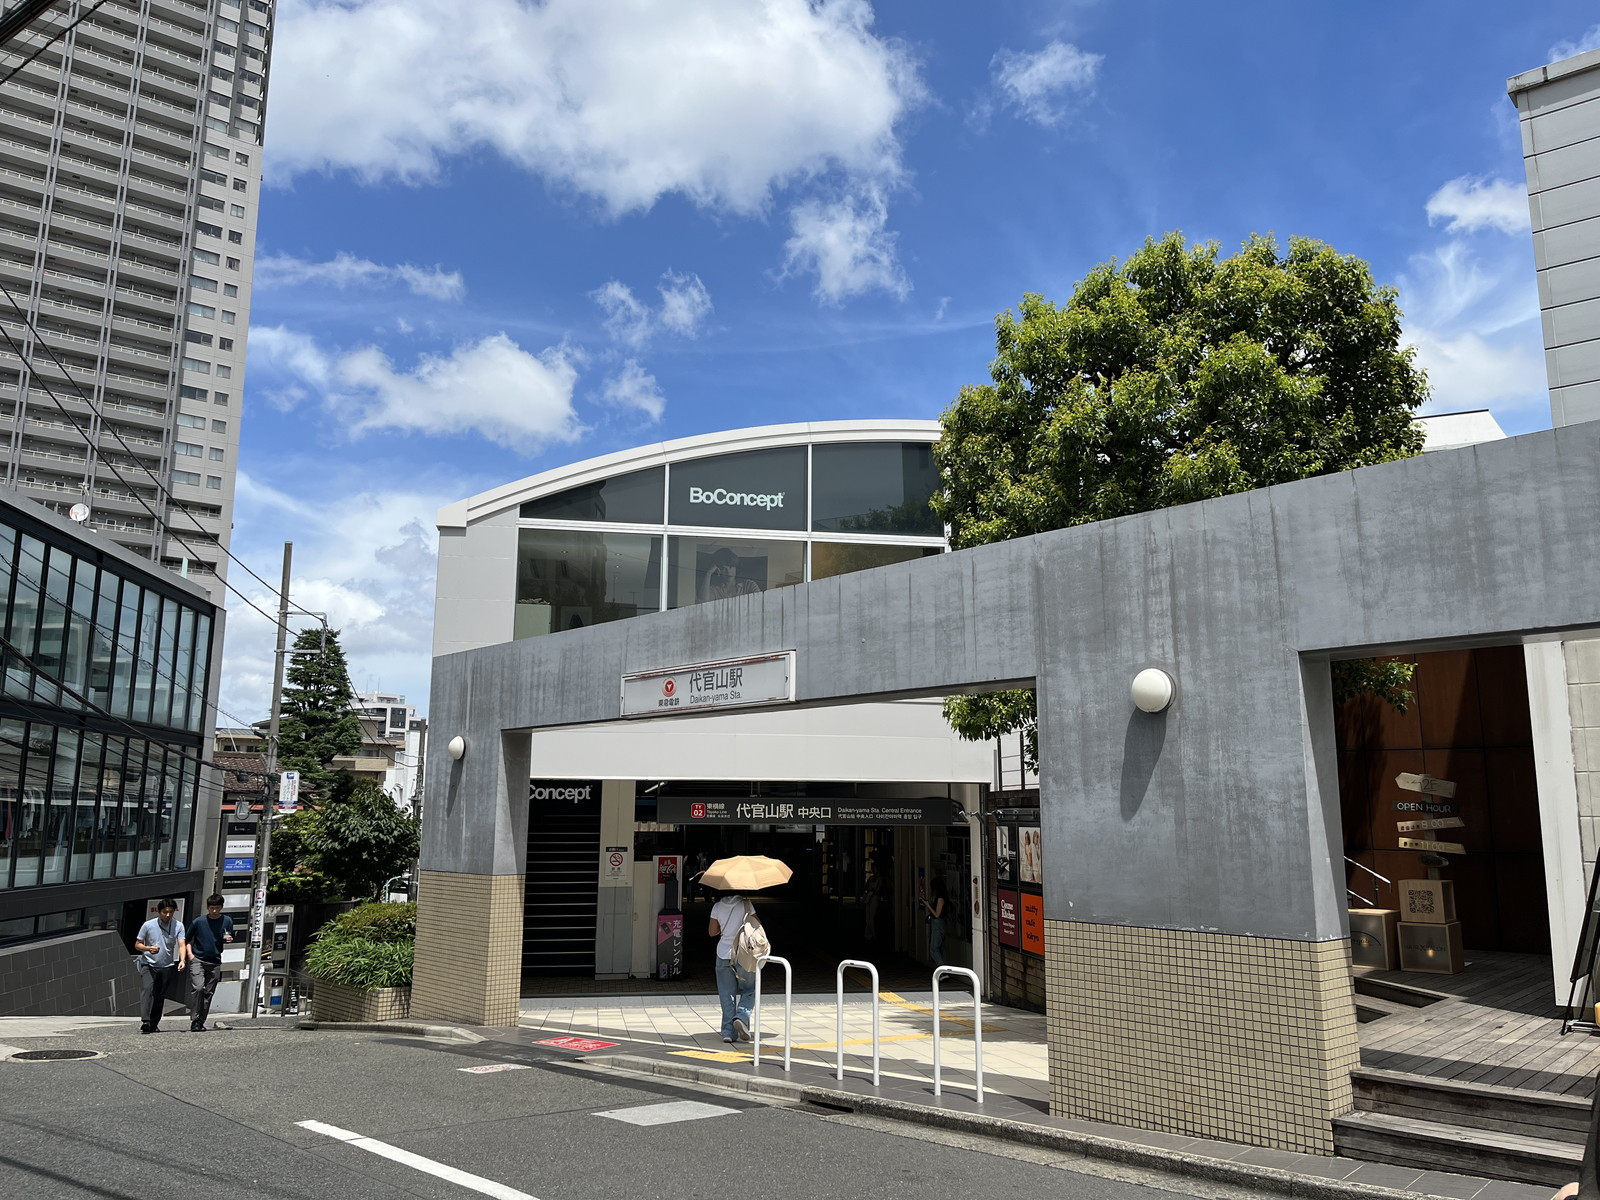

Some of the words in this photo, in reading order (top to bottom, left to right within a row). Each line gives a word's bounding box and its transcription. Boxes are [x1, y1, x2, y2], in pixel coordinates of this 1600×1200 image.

[689, 487, 784, 511] BoConcept
[689, 668, 743, 693] 代官山駅
[690, 694, 729, 704] Daikan-yama
[730, 691, 743, 700] Sta.
[736, 803, 794, 819] 代官山駅
[798, 807, 831, 818] 中央口
[1397, 802, 1423, 811] OPEN
[1426, 804, 1451, 813] HOUR
[1025, 904, 1038, 915] miffy
[1026, 919, 1036, 927] cafe
[1026, 932, 1040, 942] tokyo
[672, 919, 681, 975] 充電レンタル
